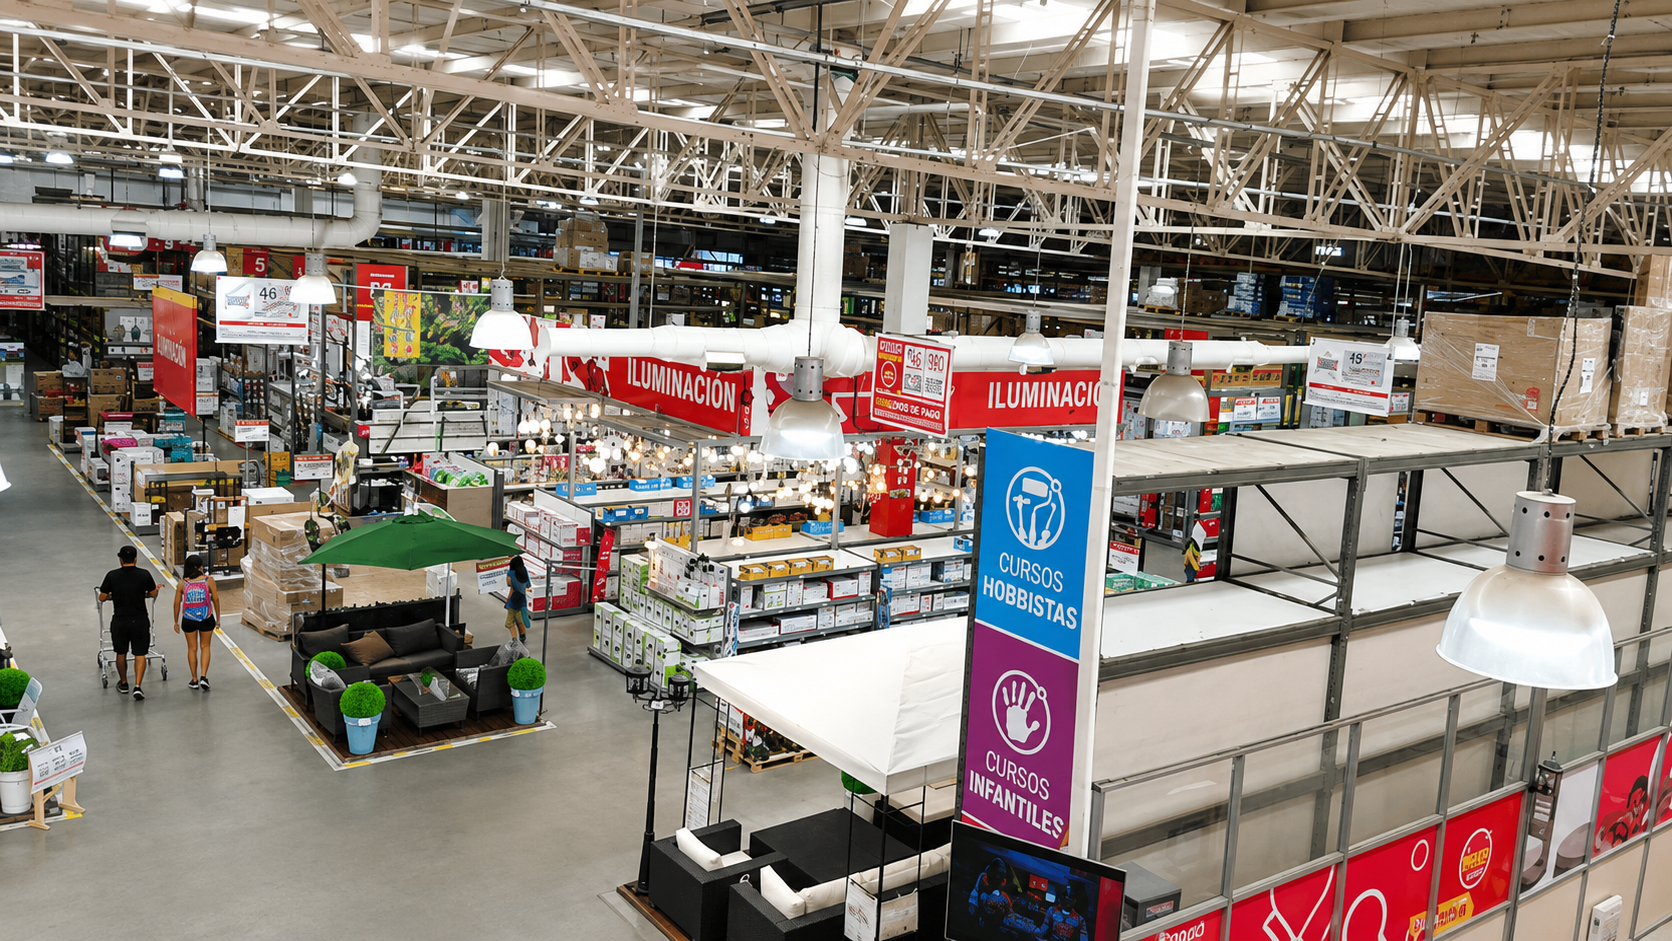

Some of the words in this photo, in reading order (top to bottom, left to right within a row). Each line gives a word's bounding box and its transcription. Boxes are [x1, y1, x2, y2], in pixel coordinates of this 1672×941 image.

[254, 257, 266, 273] 5
[259, 287, 277, 300] 46
[627, 357, 736, 413] ILUMINACIÓN
[999, 552, 1064, 593] CURSOS
[983, 575, 1078, 630] HOBBISTAS
[985, 750, 1050, 801] CURSOS
[969, 769, 1064, 839] INFANTILES
